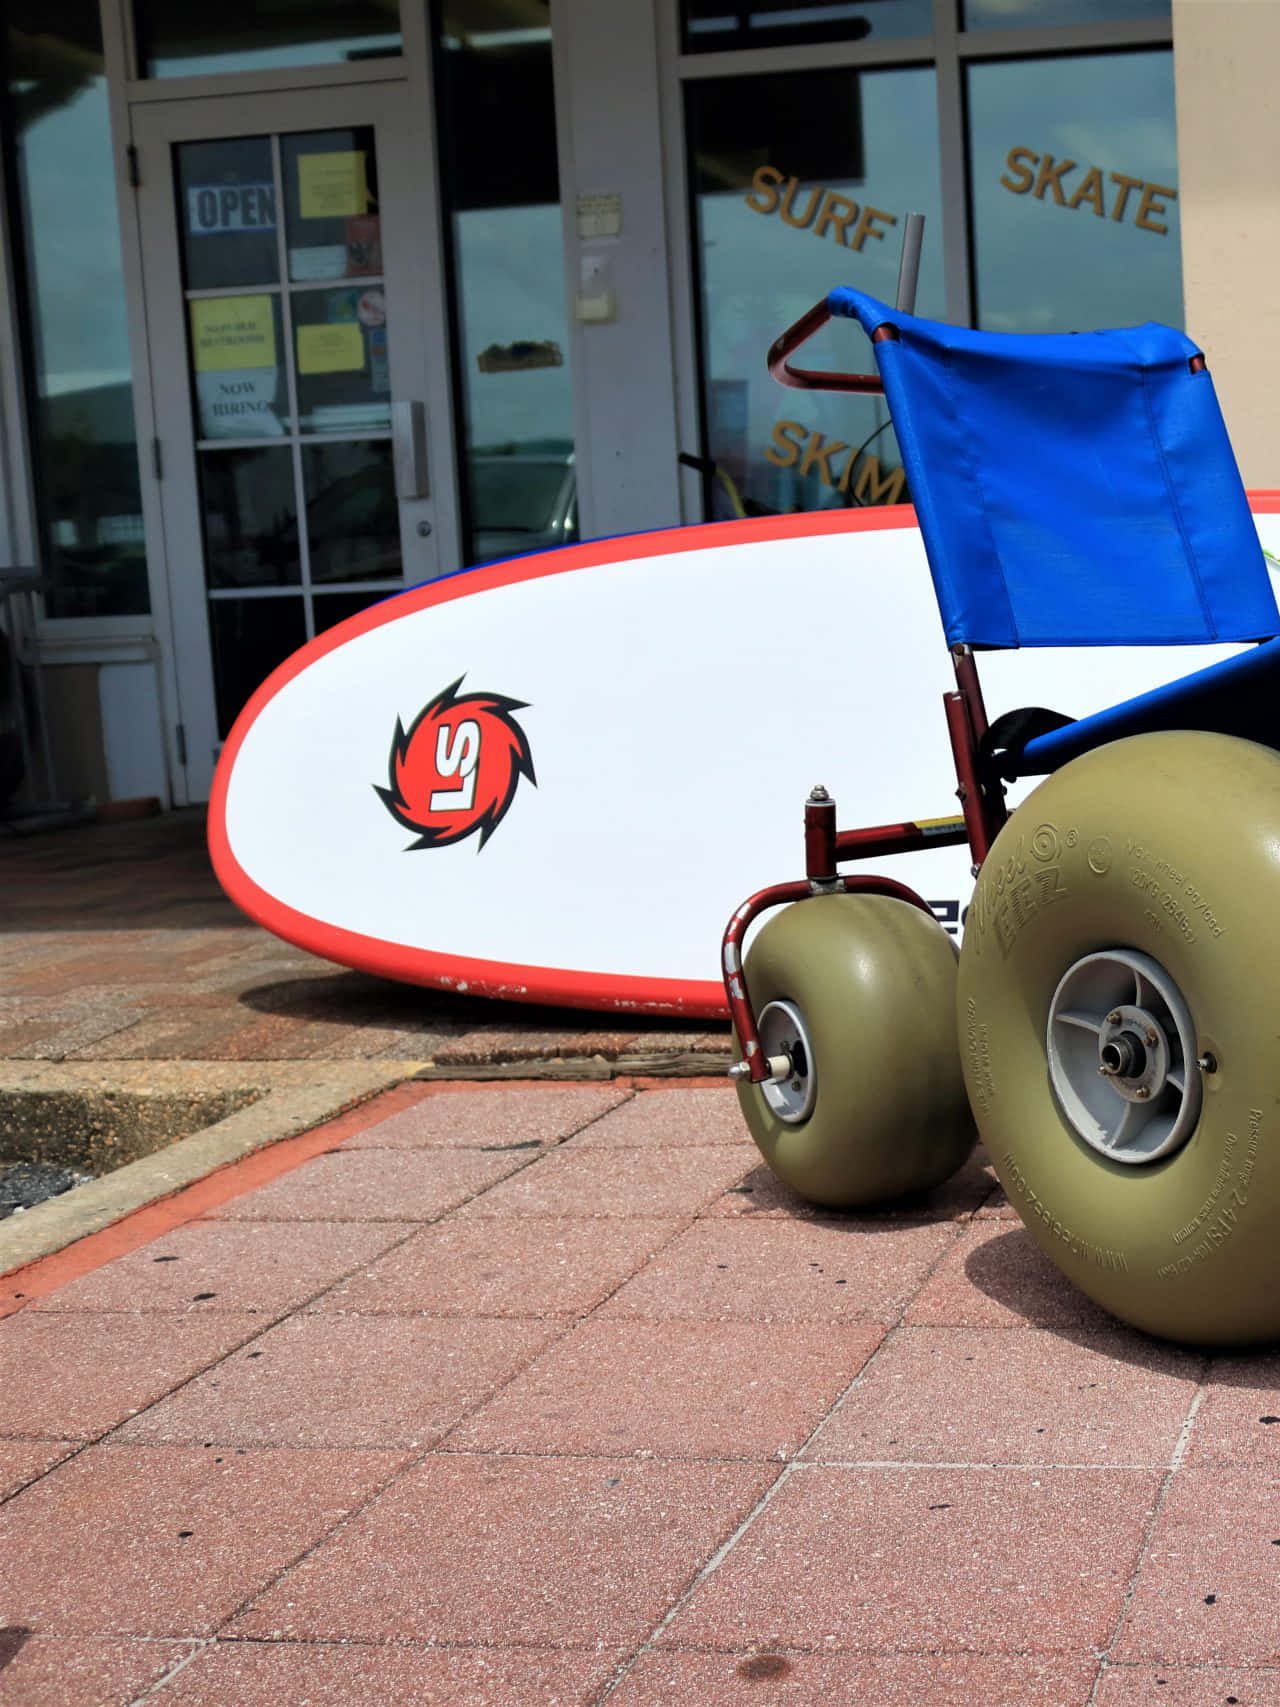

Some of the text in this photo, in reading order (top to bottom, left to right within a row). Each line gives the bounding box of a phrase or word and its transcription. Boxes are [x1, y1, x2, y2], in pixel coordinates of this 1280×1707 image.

[198, 187, 276, 228] OPEN
[744, 165, 896, 252] SURF
[1000, 146, 1177, 235] SKATE
[213, 400, 269, 416] HIRING
[218, 381, 256, 394] NOW
[763, 420, 905, 504] SKIM
[429, 719, 481, 812] LS
